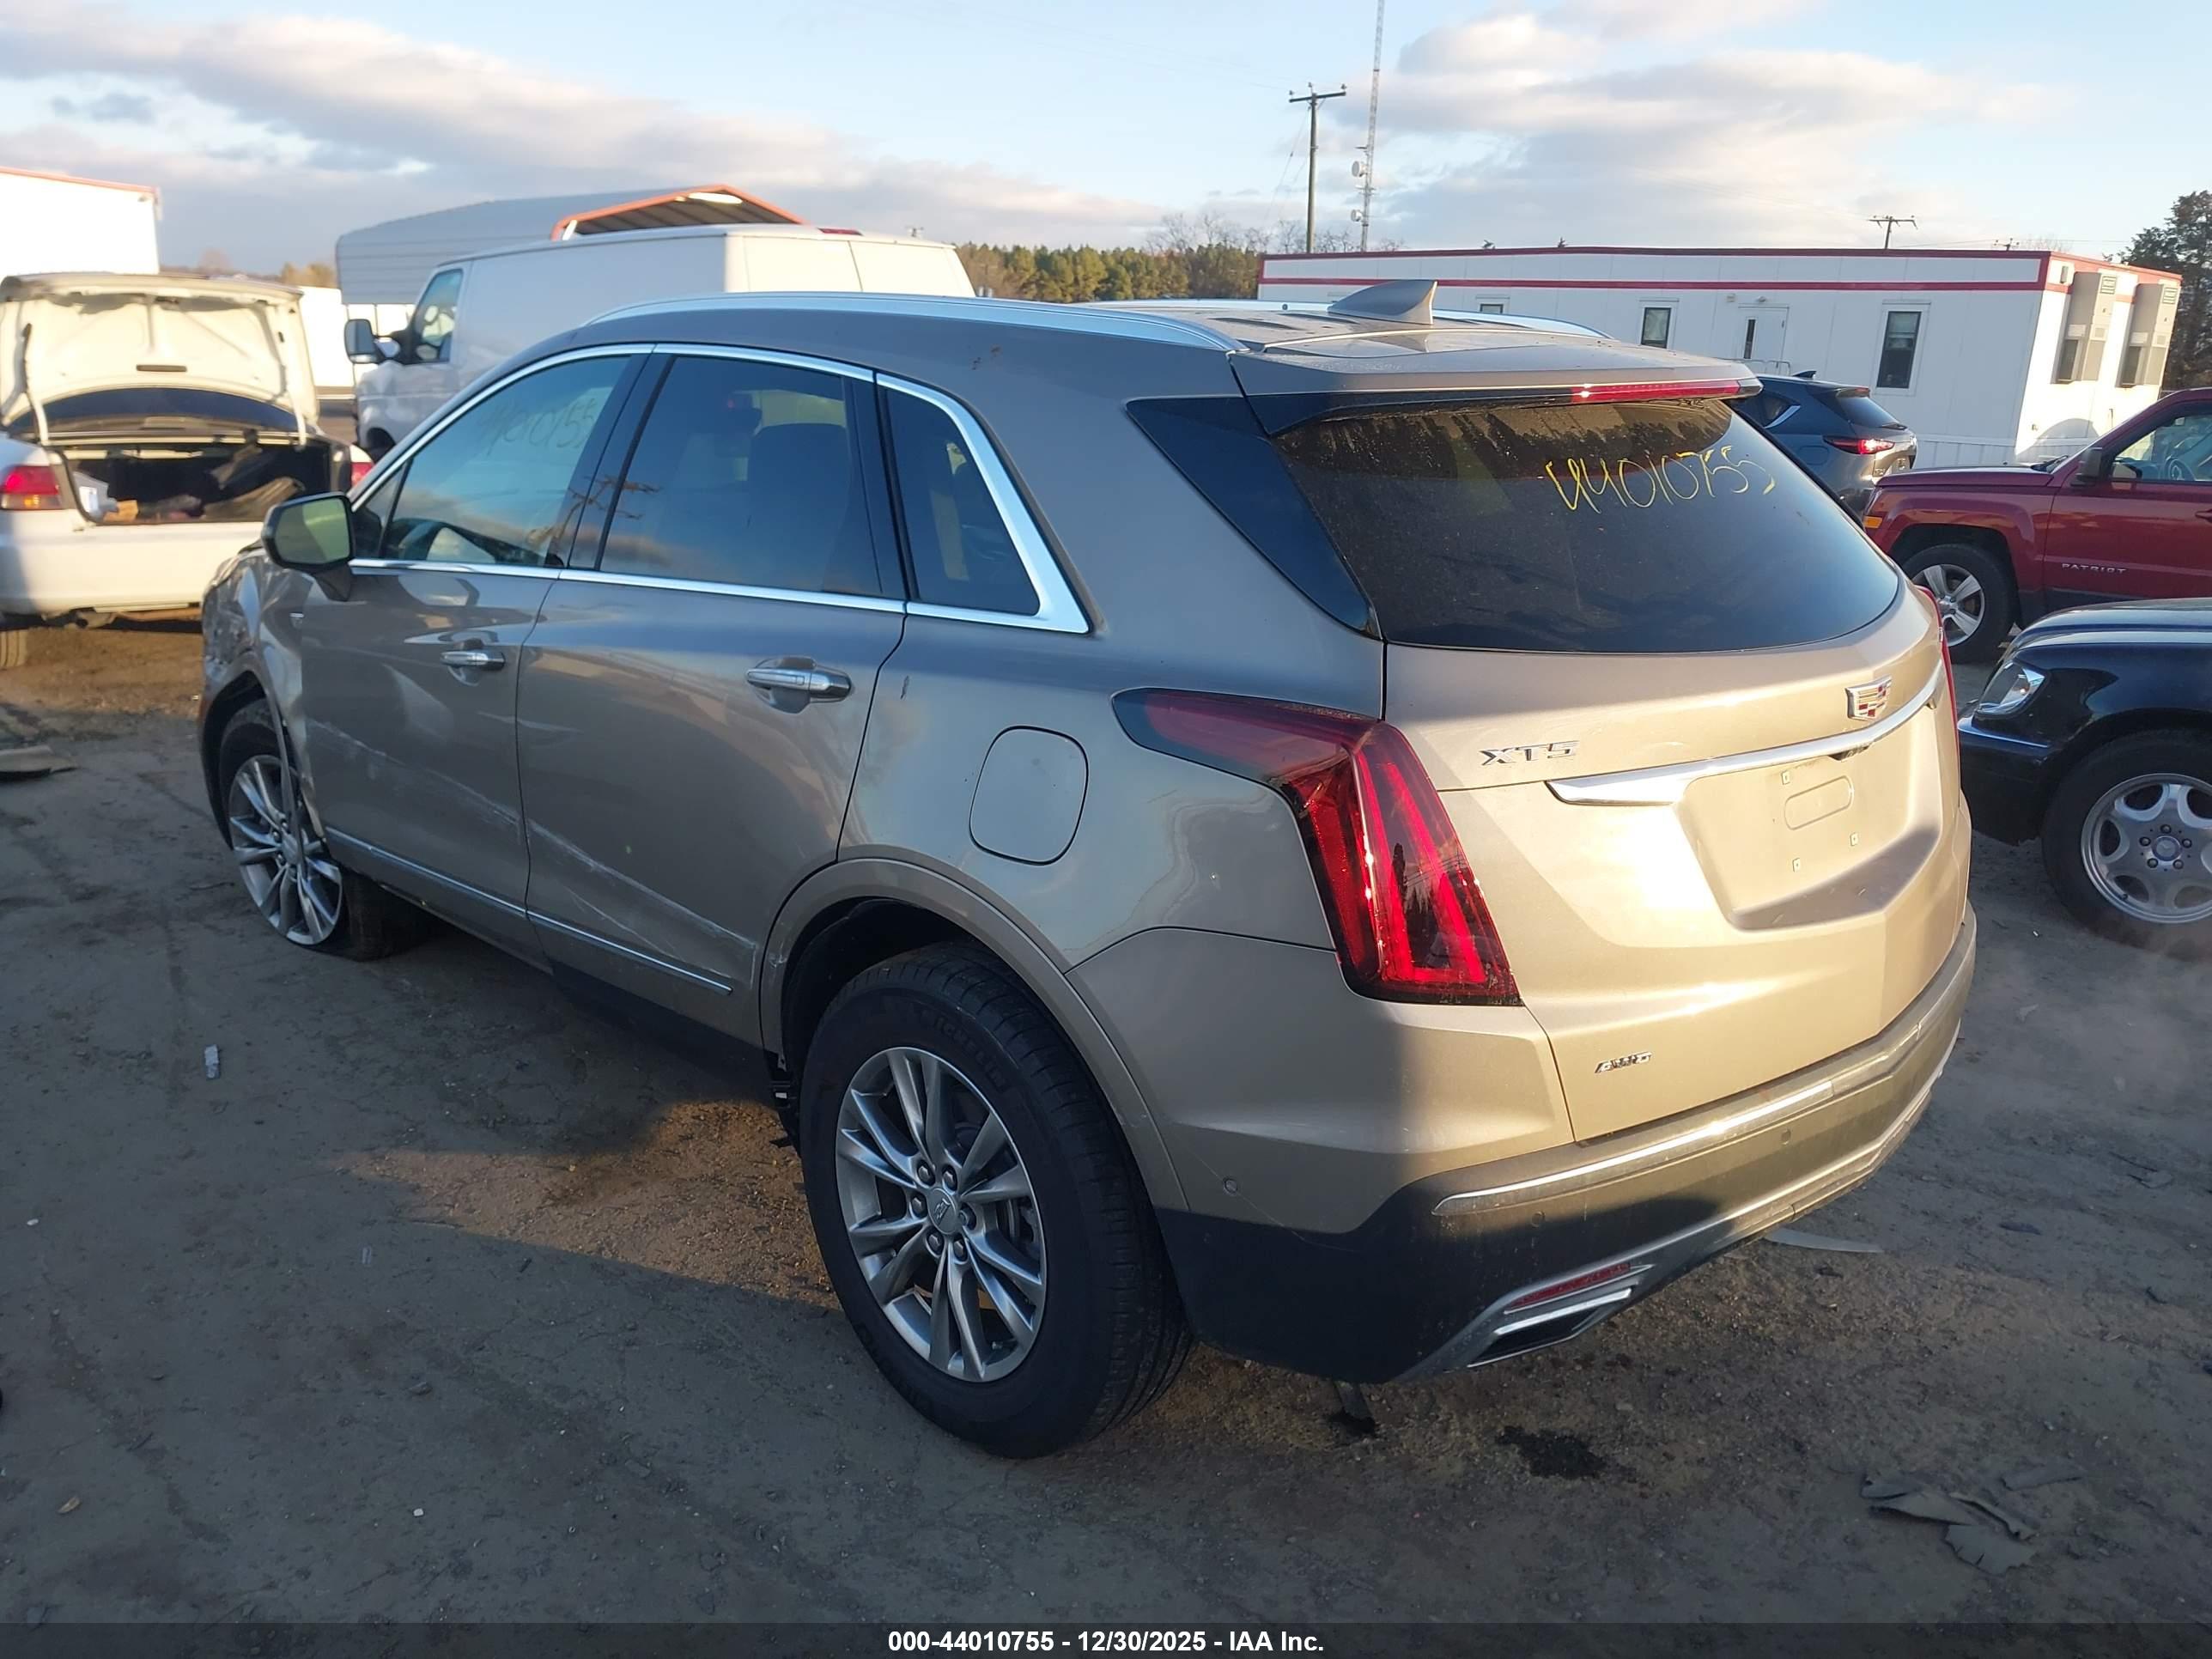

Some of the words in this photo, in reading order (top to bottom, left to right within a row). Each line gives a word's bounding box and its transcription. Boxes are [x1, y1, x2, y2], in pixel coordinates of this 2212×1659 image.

[1545, 445, 1776, 514] 44010755
[2062, 562, 2127, 574] PATRIOT
[1480, 740, 1579, 767] XT5
[1594, 1052, 1652, 1073] AWD
